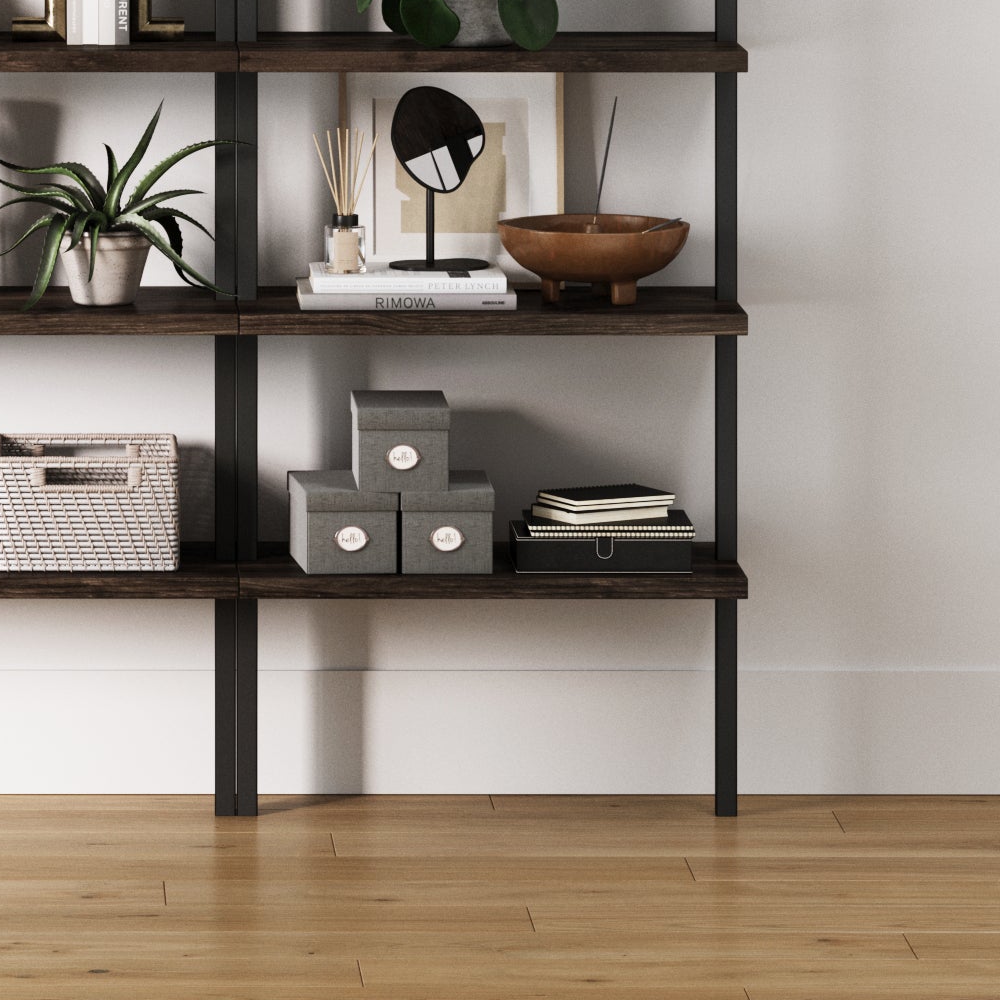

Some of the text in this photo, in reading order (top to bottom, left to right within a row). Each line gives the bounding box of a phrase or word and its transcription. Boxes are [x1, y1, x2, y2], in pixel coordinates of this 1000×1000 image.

[428, 281, 462, 290] PETER
[465, 281, 499, 290] LYNCH
[375, 297, 436, 309] RIMOWA
[392, 450, 413, 465] hello!
[340, 532, 361, 546] hello!
[435, 532, 456, 546] hello!
